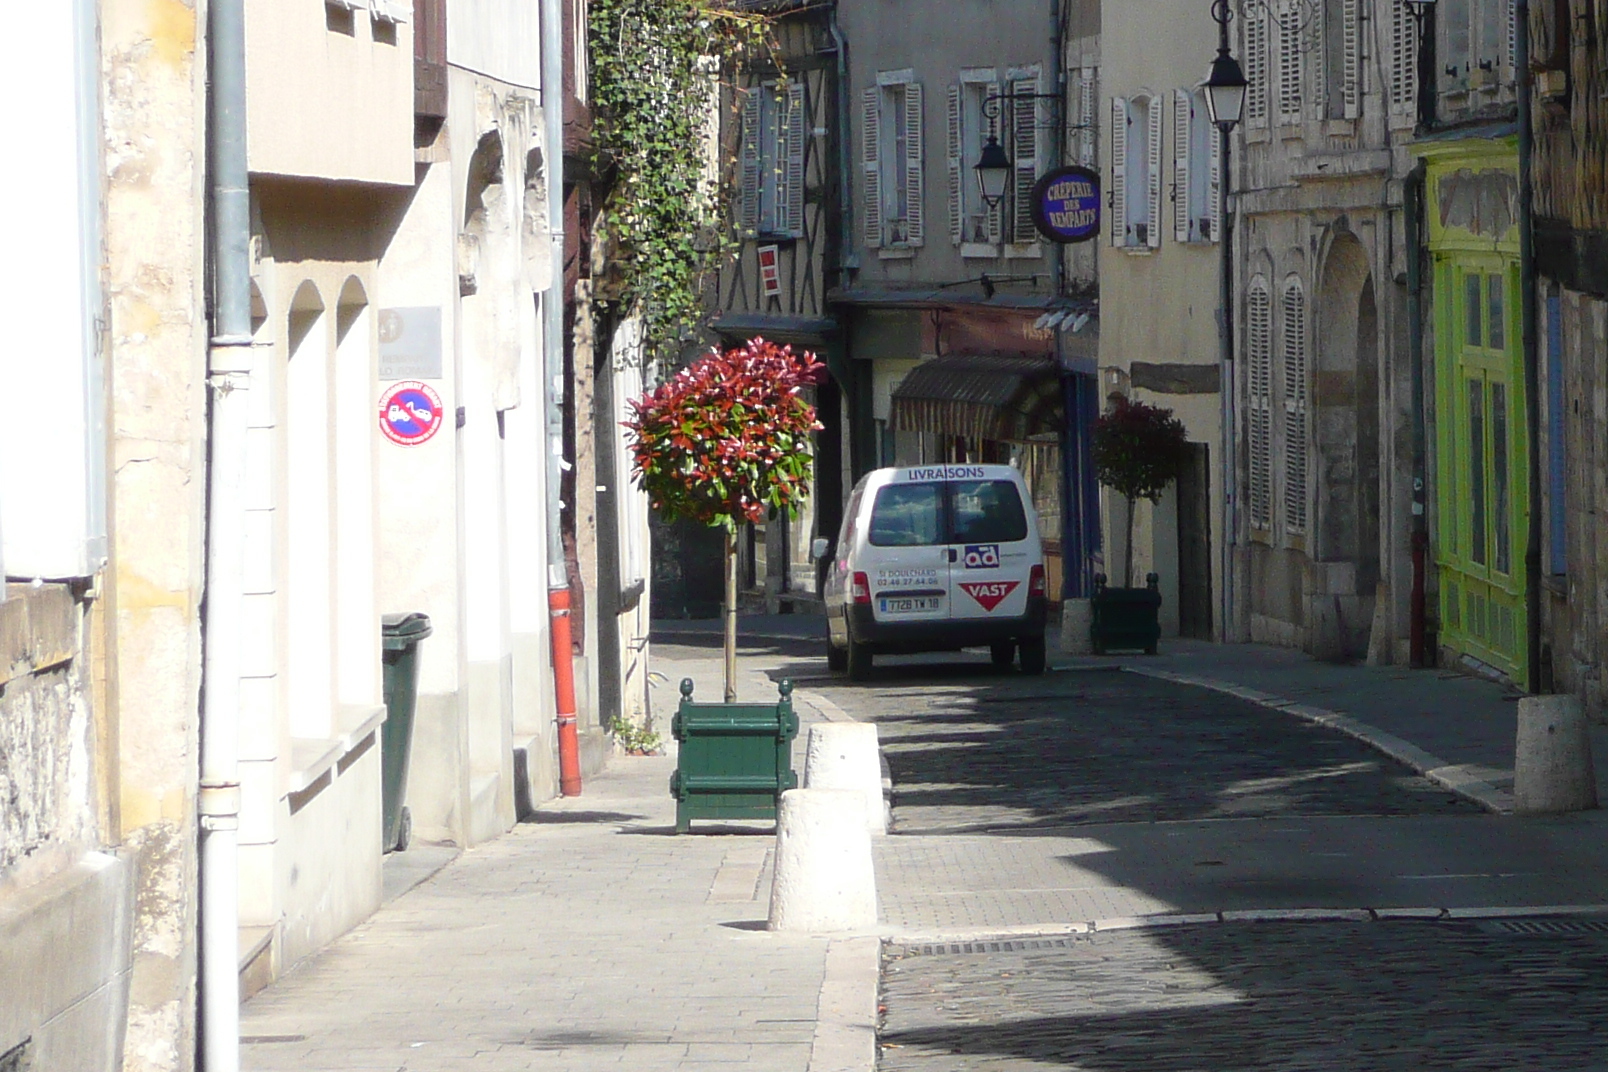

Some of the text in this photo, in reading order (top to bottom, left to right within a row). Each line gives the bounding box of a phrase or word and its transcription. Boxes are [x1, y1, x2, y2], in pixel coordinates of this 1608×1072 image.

[1064, 200, 1080, 211] DES
[1049, 209, 1096, 228] REMPARTS
[908, 467, 985, 480] LIVRAISONS
[968, 584, 1008, 597] VAST
